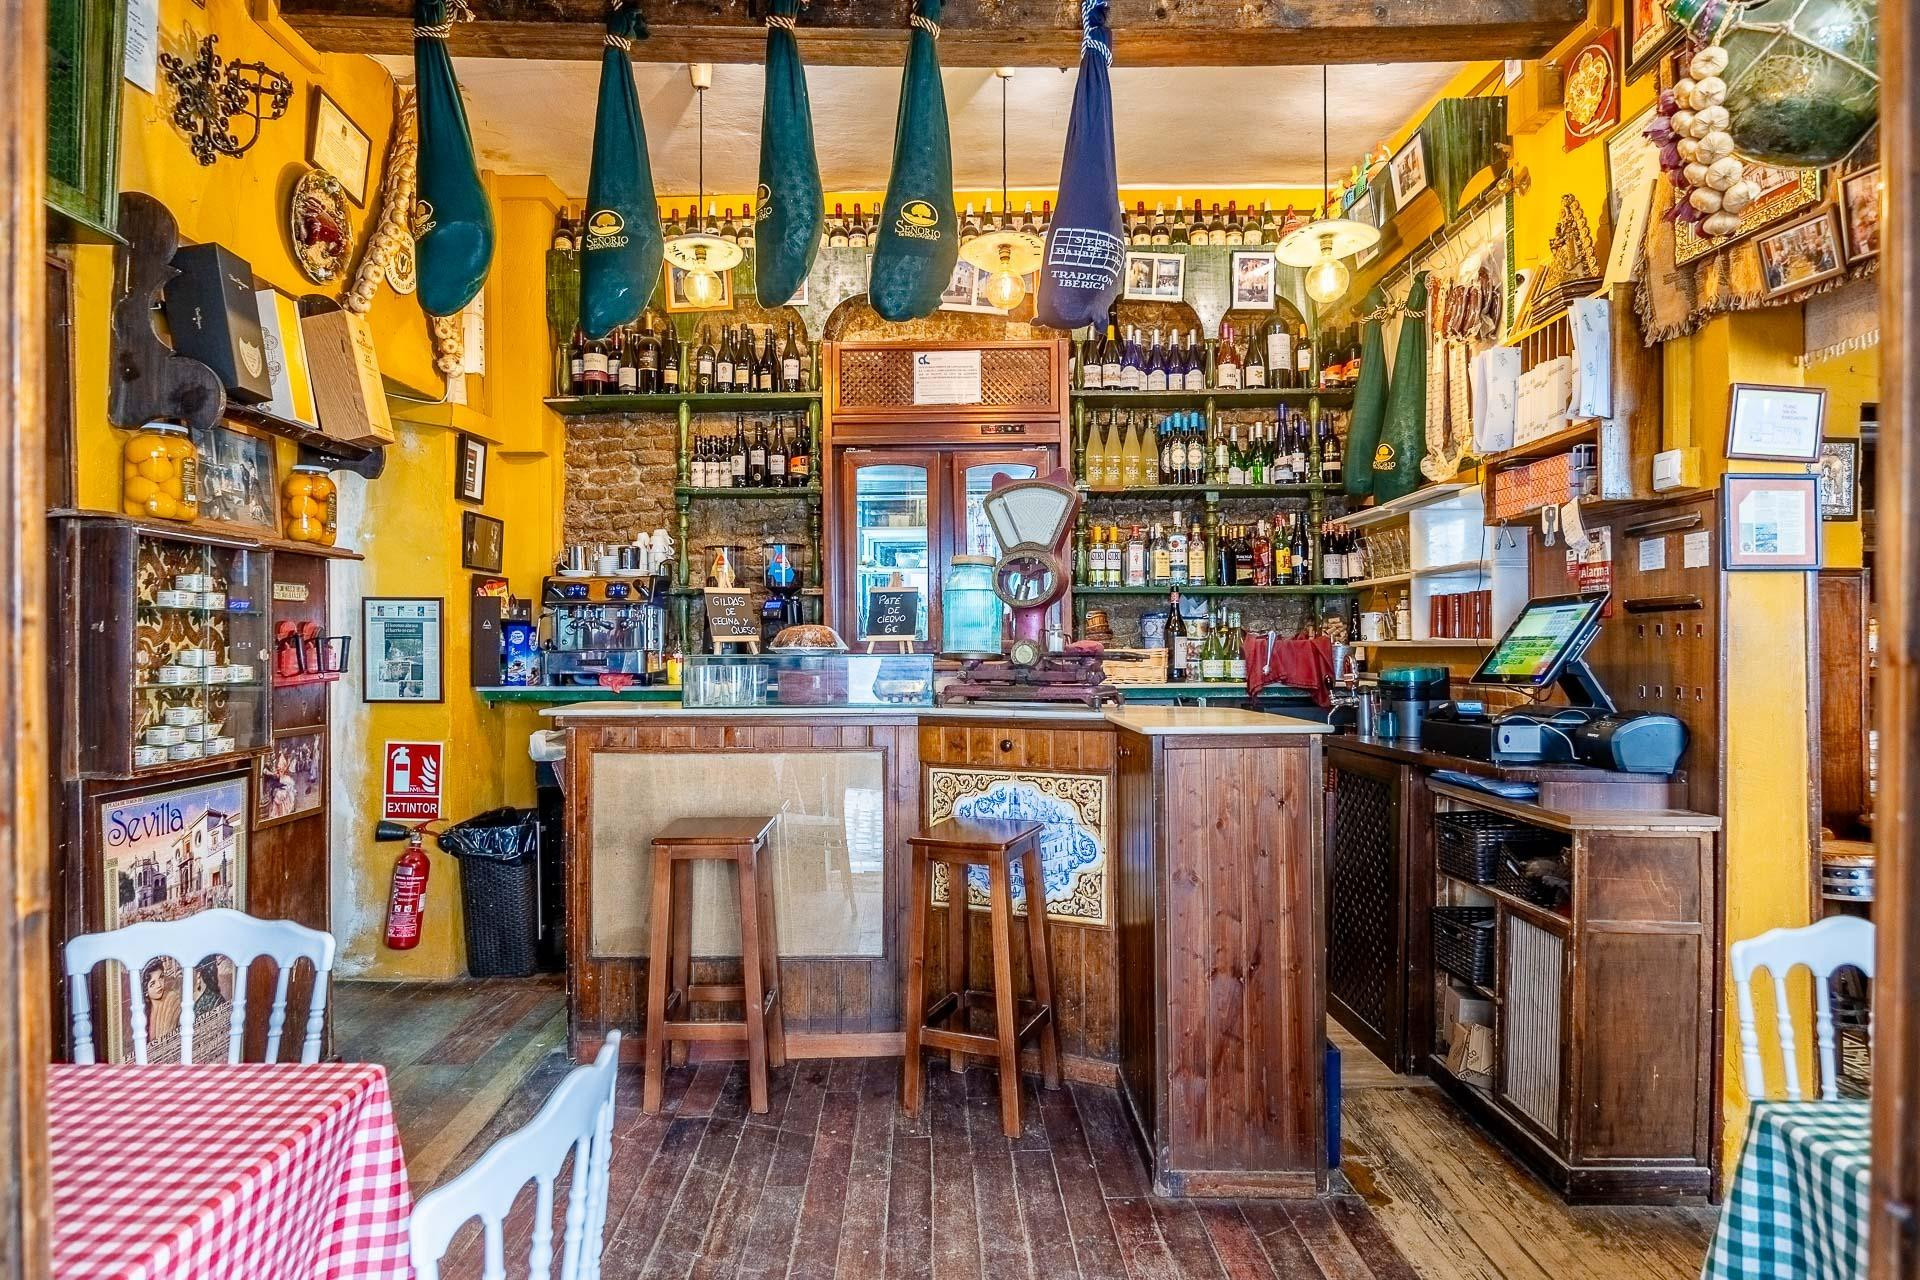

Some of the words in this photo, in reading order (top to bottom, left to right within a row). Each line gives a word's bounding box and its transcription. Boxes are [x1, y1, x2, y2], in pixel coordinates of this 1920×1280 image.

[1051, 270, 1114, 287] TRADICIÓN
[1580, 566, 1610, 579] Alarma
[712, 596, 746, 607] GILDAS
[878, 594, 903, 605] PATÉ
[725, 607, 736, 616] DE
[887, 606, 901, 615] DE
[711, 616, 740, 626] CECINA
[743, 617, 749, 626] Y
[731, 625, 757, 635] QUESO
[884, 624, 899, 634] 6€
[387, 802, 438, 814] EXTINTOR
[107, 801, 184, 848] Sevilla
